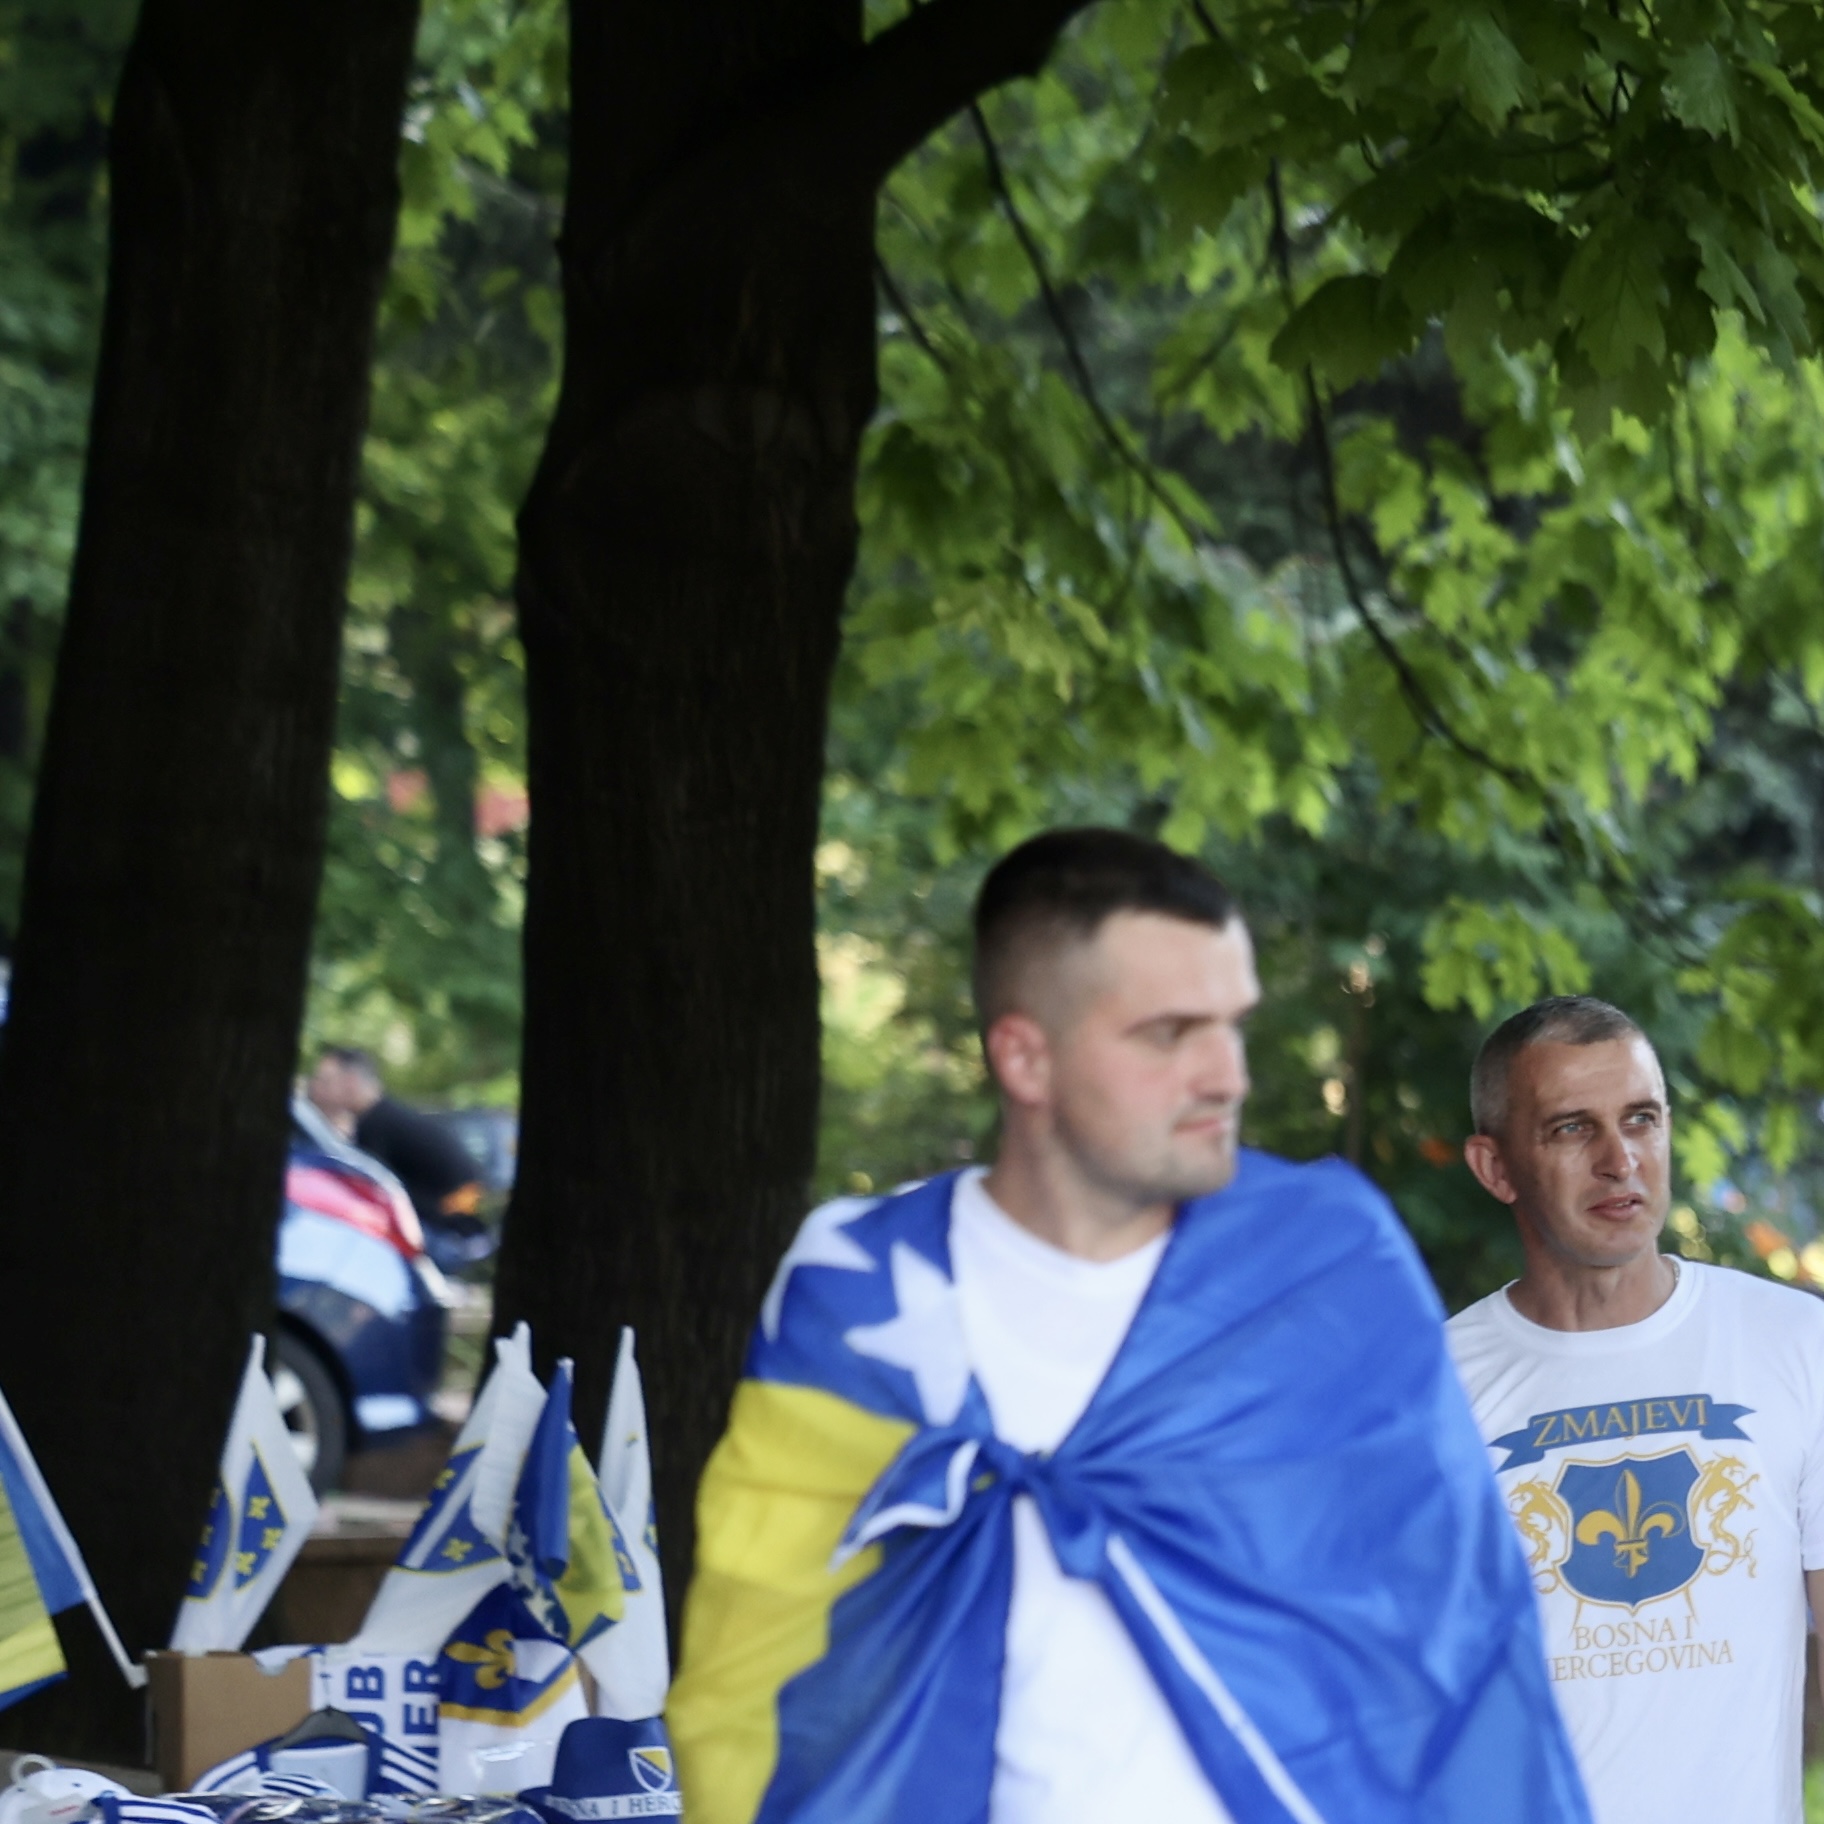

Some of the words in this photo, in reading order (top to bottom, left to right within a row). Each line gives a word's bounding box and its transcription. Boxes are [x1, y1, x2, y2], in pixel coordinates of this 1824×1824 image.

[1531, 1398, 1709, 1448] ZMAJEVI
[1574, 1619, 1676, 1651] BOSNA
[1684, 1615, 1695, 1640] I
